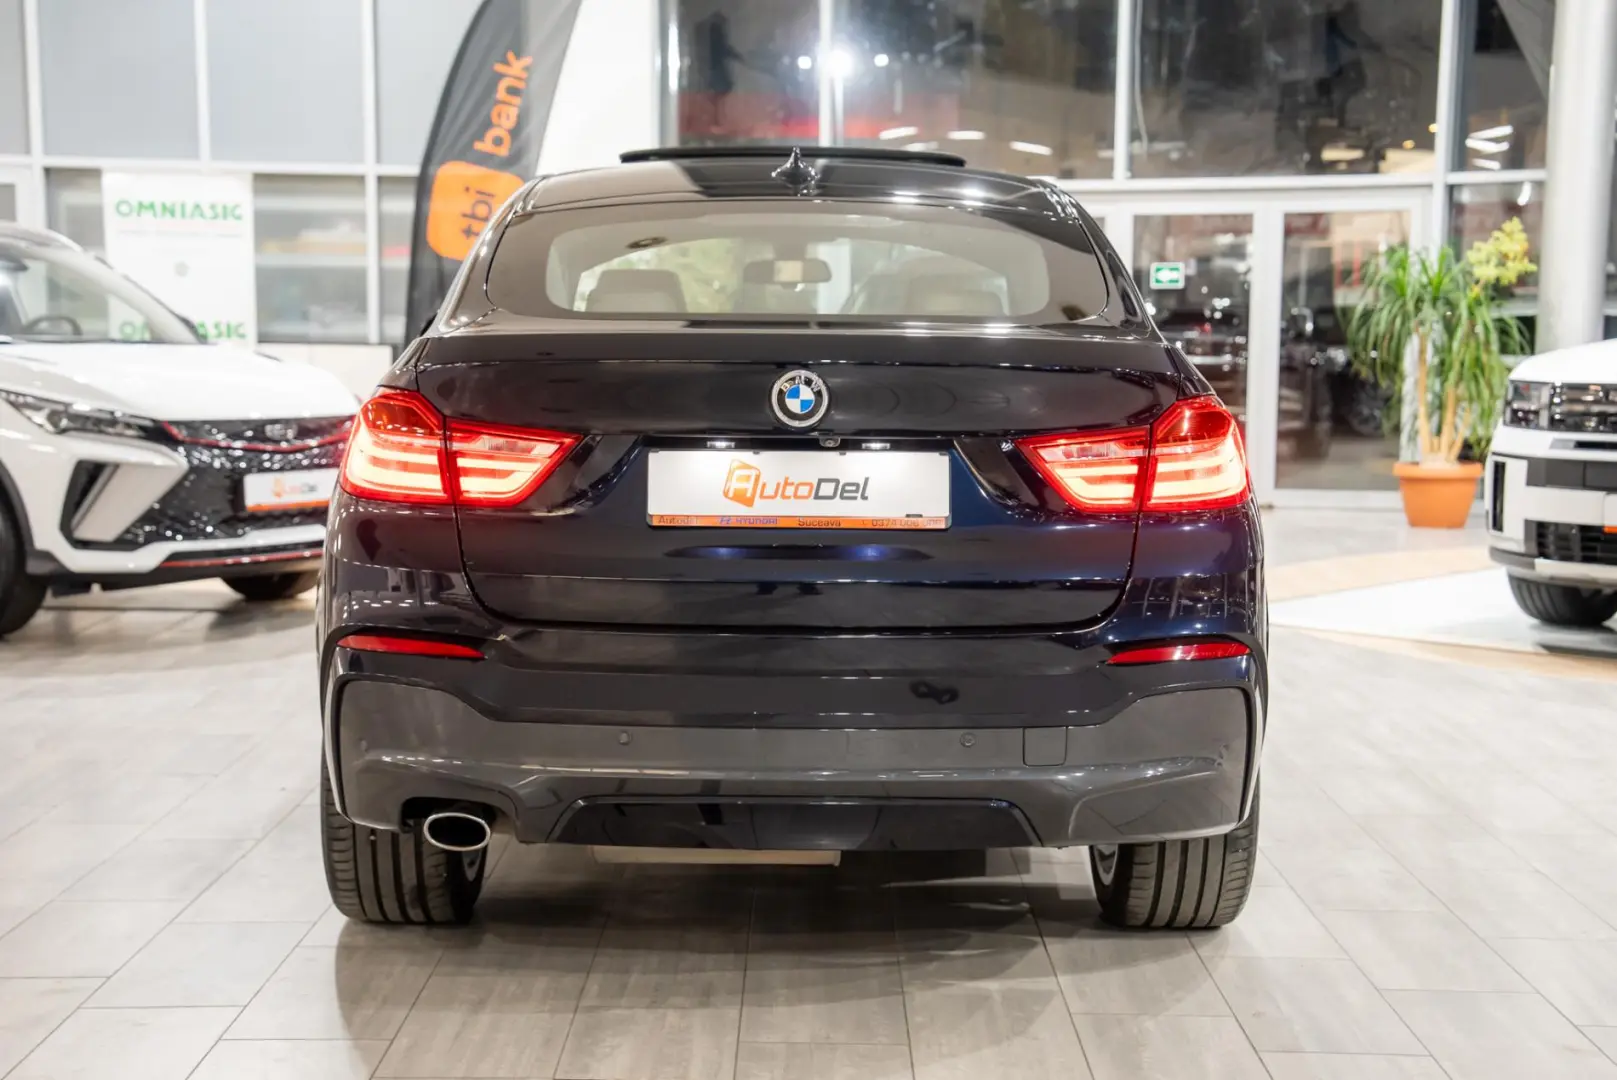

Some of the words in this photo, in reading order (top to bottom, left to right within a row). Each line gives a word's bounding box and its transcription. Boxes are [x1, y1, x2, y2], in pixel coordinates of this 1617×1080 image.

[473, 50, 533, 156] bank
[460, 185, 495, 241] tbi
[780, 374, 821, 393] BMW
[724, 462, 870, 505] AutoDel
[797, 516, 841, 527] Suceava
